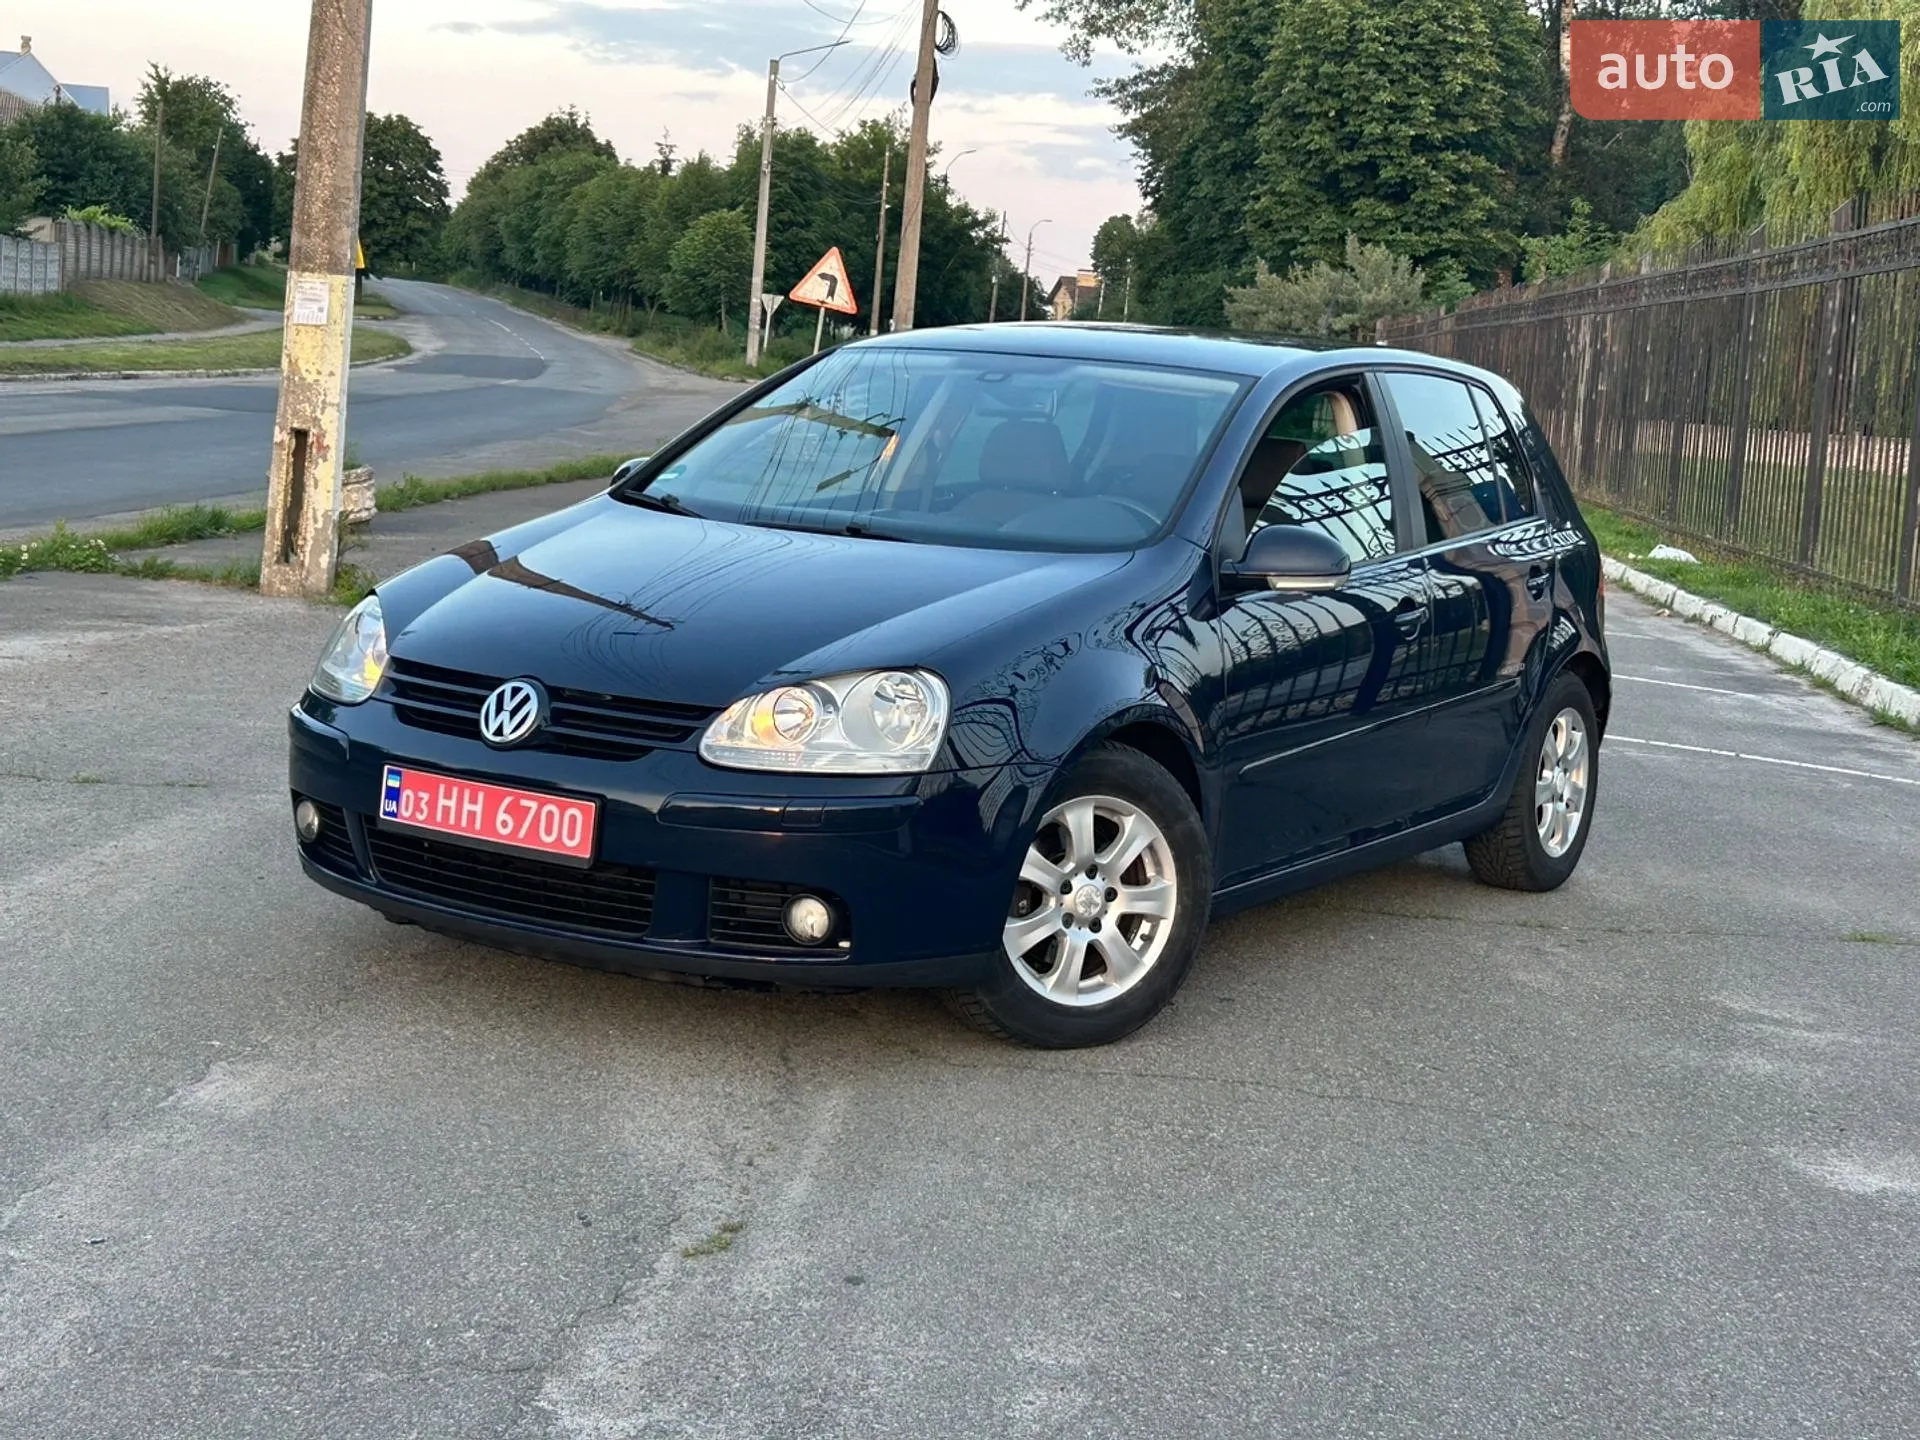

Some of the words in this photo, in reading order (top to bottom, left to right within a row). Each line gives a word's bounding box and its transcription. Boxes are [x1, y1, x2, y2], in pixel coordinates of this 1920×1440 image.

[481, 681, 539, 743] VW
[384, 798, 398, 813] UA
[401, 788, 430, 821] 03
[435, 783, 485, 831] HH
[495, 795, 584, 848] 6700
